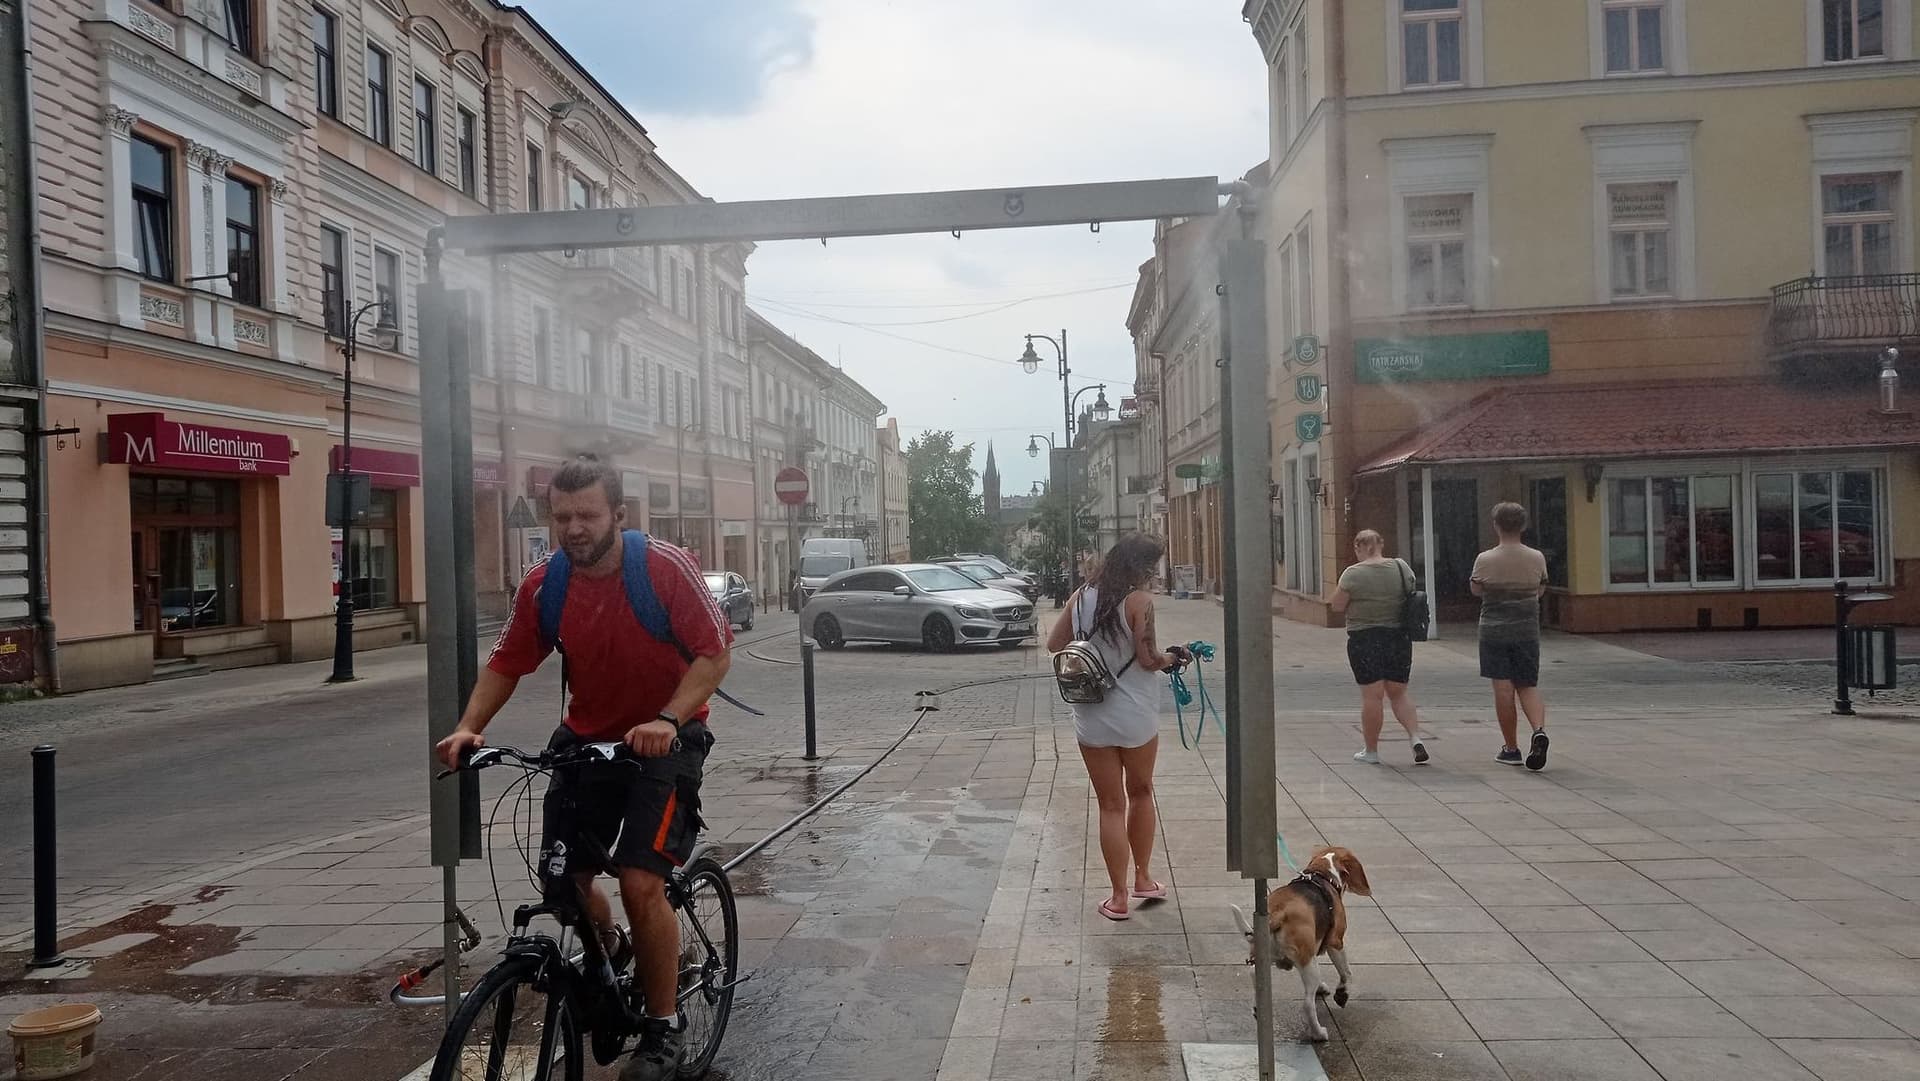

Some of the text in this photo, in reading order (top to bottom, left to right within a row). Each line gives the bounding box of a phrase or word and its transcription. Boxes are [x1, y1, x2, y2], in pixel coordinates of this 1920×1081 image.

[123, 431, 156, 463] M
[178, 423, 264, 458] Millennium
[239, 459, 257, 471] bank
